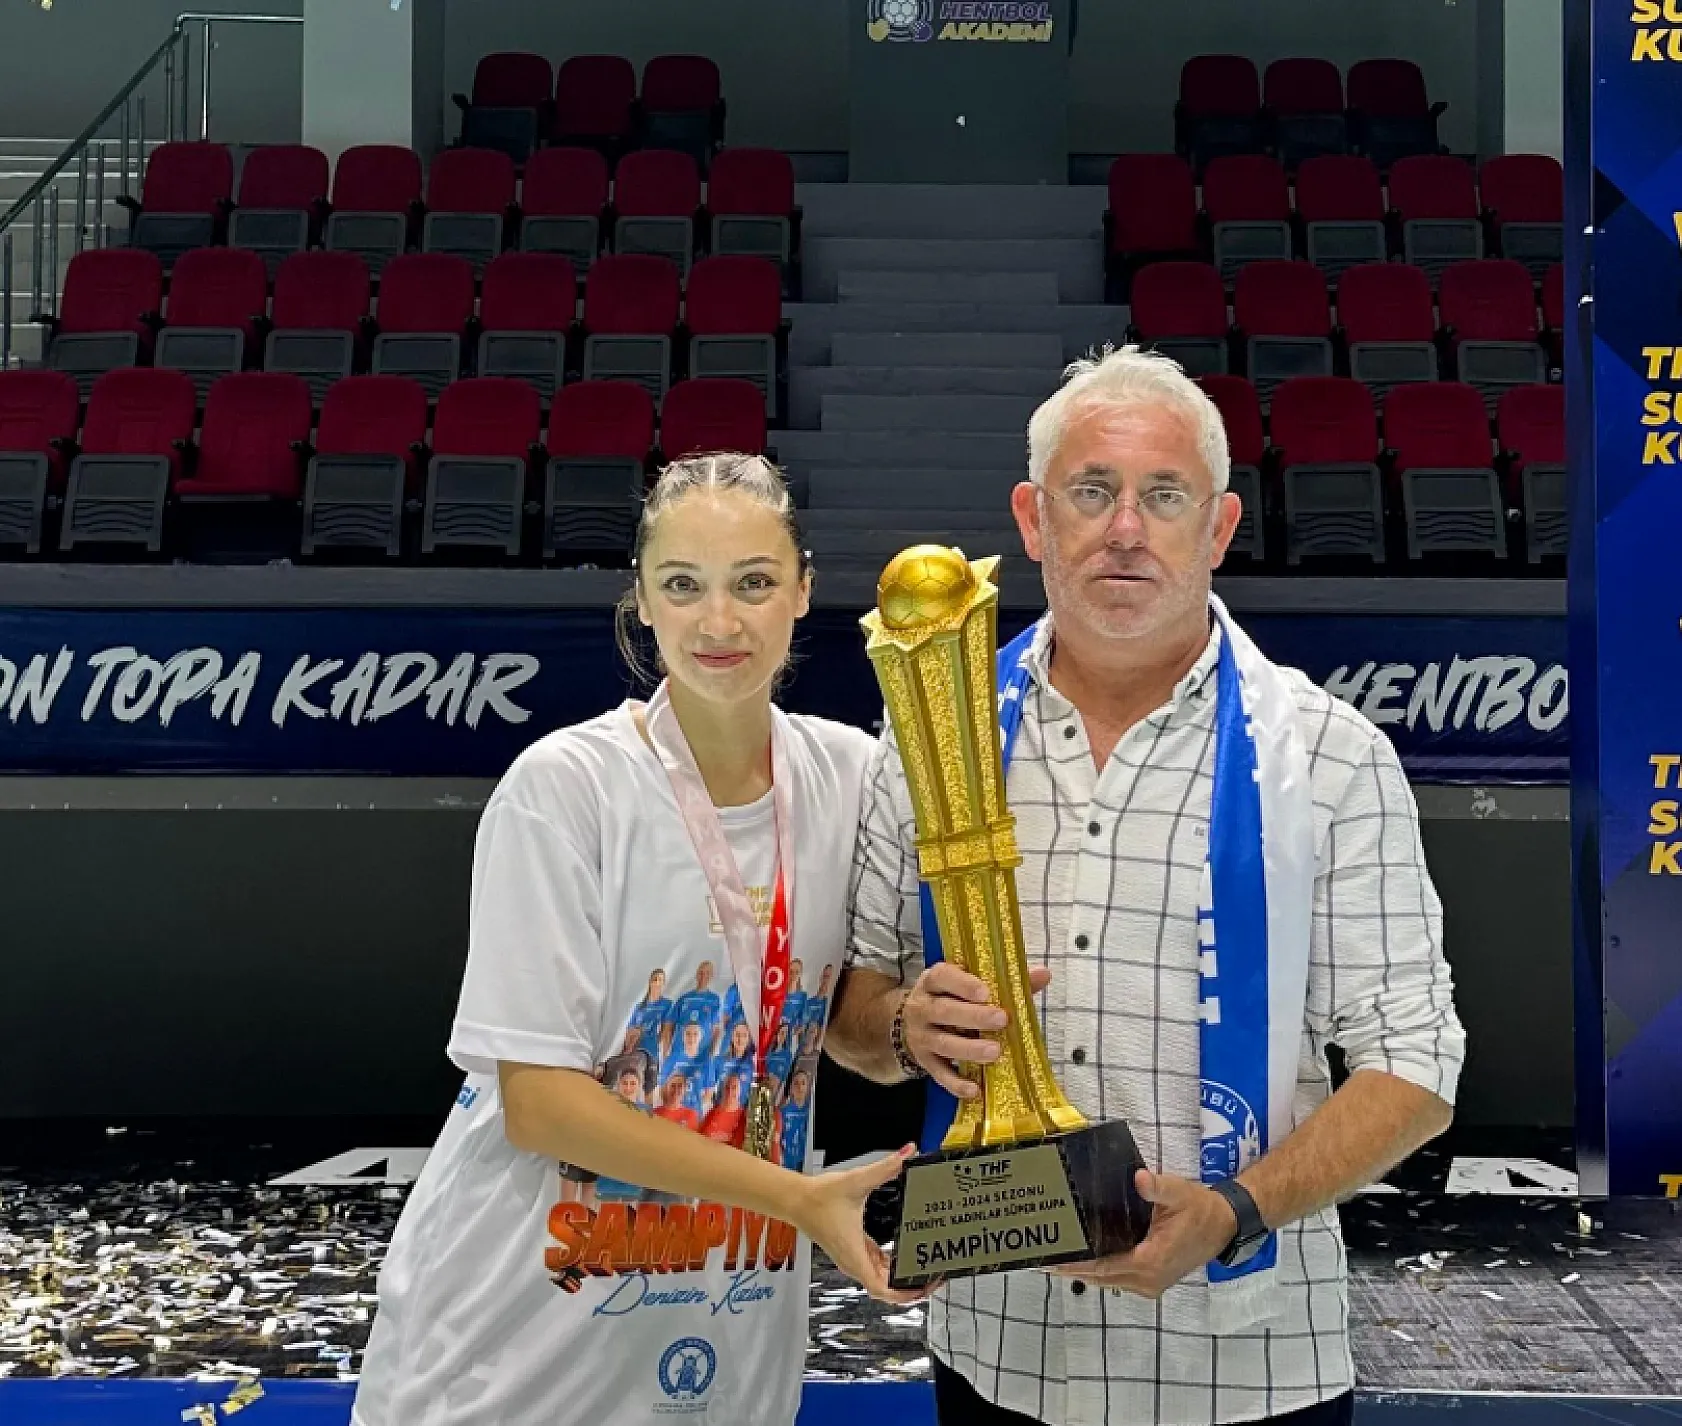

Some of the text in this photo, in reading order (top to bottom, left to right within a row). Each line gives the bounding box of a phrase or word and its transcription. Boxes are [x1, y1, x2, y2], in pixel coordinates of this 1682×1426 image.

[939, 1, 1051, 20] HENTBOL
[81, 645, 260, 728] TOPA
[272, 652, 540, 729] KADAR
[978, 1159, 1011, 1177] THF
[993, 1185, 1045, 1203] SEZONU
[916, 1221, 1060, 1271] ŞAMPİYONU
